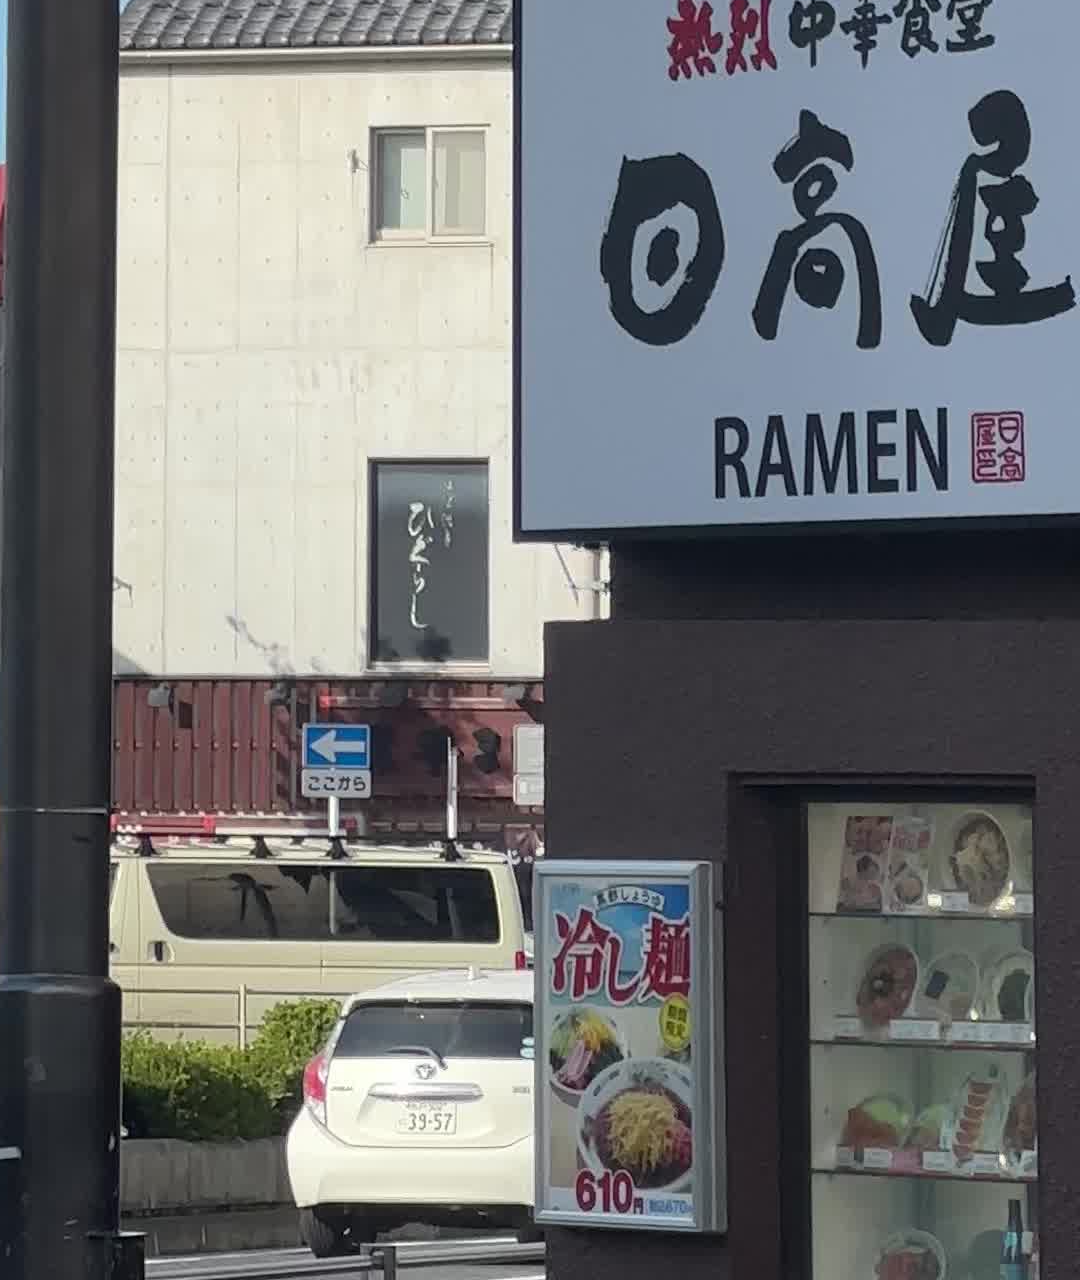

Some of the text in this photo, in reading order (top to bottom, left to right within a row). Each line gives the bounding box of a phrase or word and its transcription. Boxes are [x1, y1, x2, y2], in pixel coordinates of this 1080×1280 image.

[600, 89, 1077, 349] 日高屋
[714, 407, 949, 499] RAMEN
[408, 502, 435, 629] ひぐらし
[308, 776, 366, 792] ここから
[553, 908, 690, 1003] 冷し麺
[408, 1113, 453, 1130] 39-57
